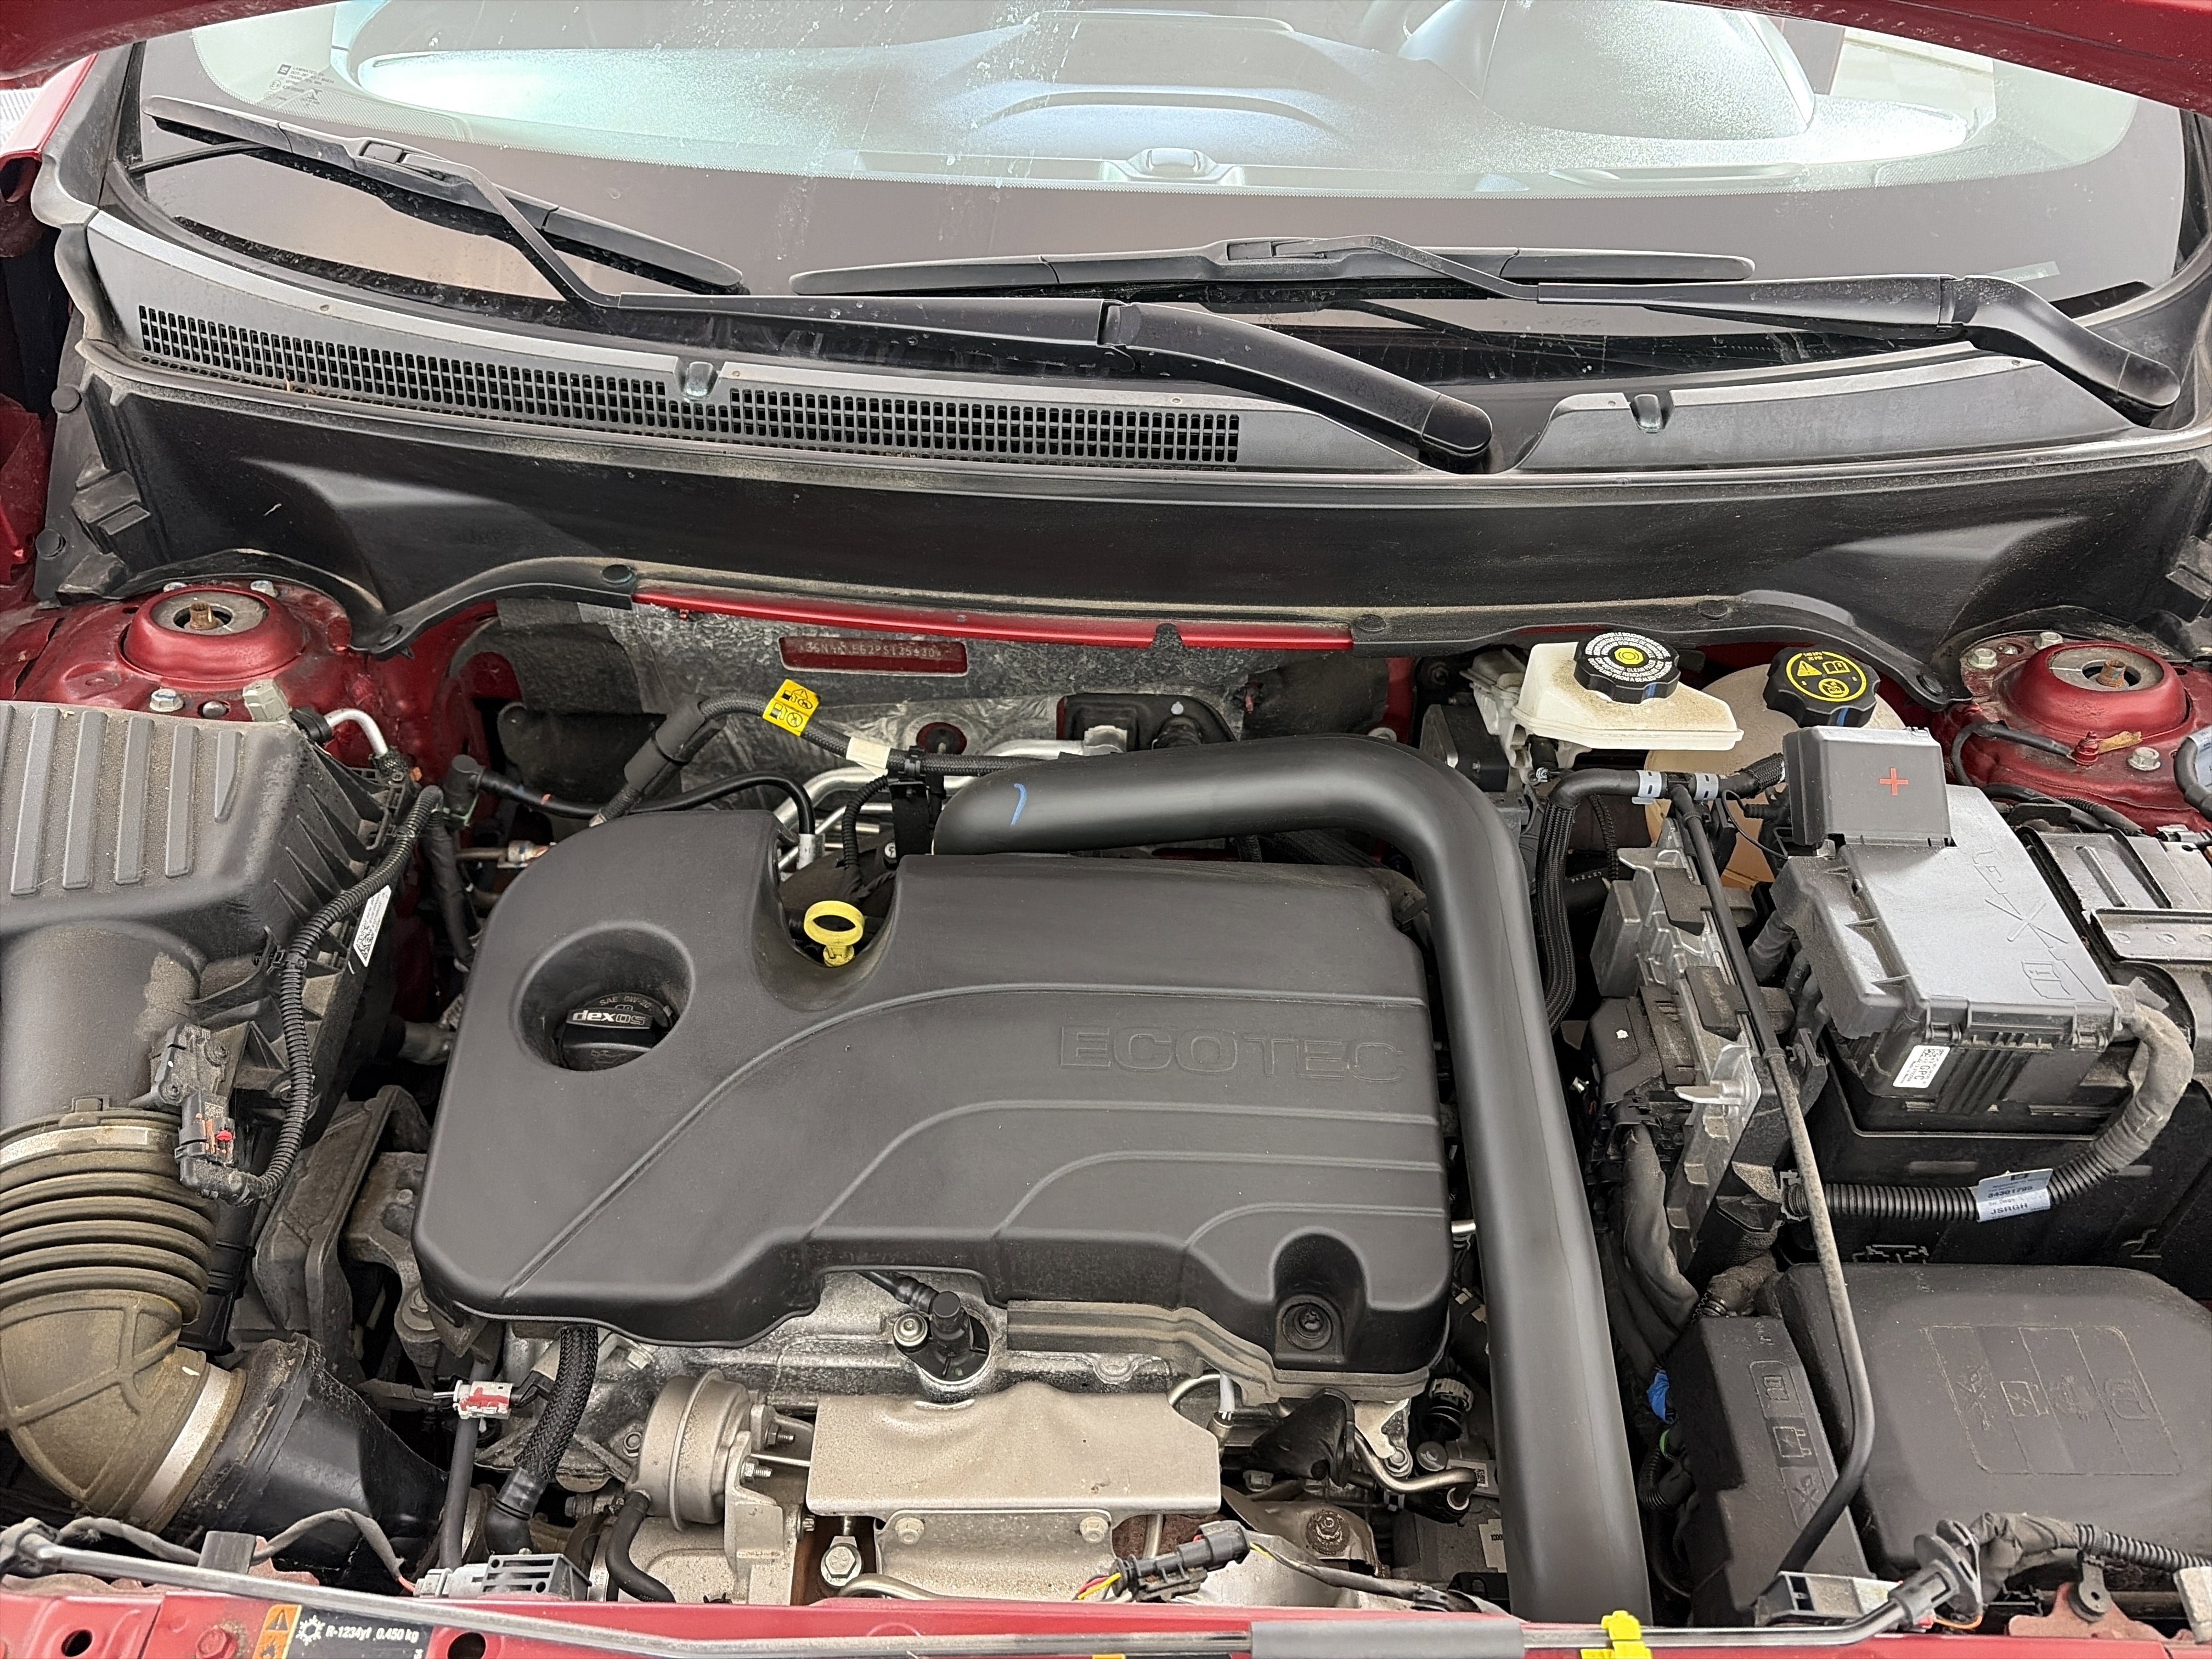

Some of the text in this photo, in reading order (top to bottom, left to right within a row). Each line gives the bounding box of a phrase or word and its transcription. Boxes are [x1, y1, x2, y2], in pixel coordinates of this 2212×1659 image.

[1602, 664, 1622, 675] BEFORE
[600, 995, 652, 1009] SAE 0W-20
[572, 1009, 646, 1025] dexos
[1061, 1026, 1406, 1082] ECOTEC
[1914, 1065, 1931, 1080] GPC
[325, 1624, 372, 1641] R-1234yf
[405, 1629, 420, 1644] kg
